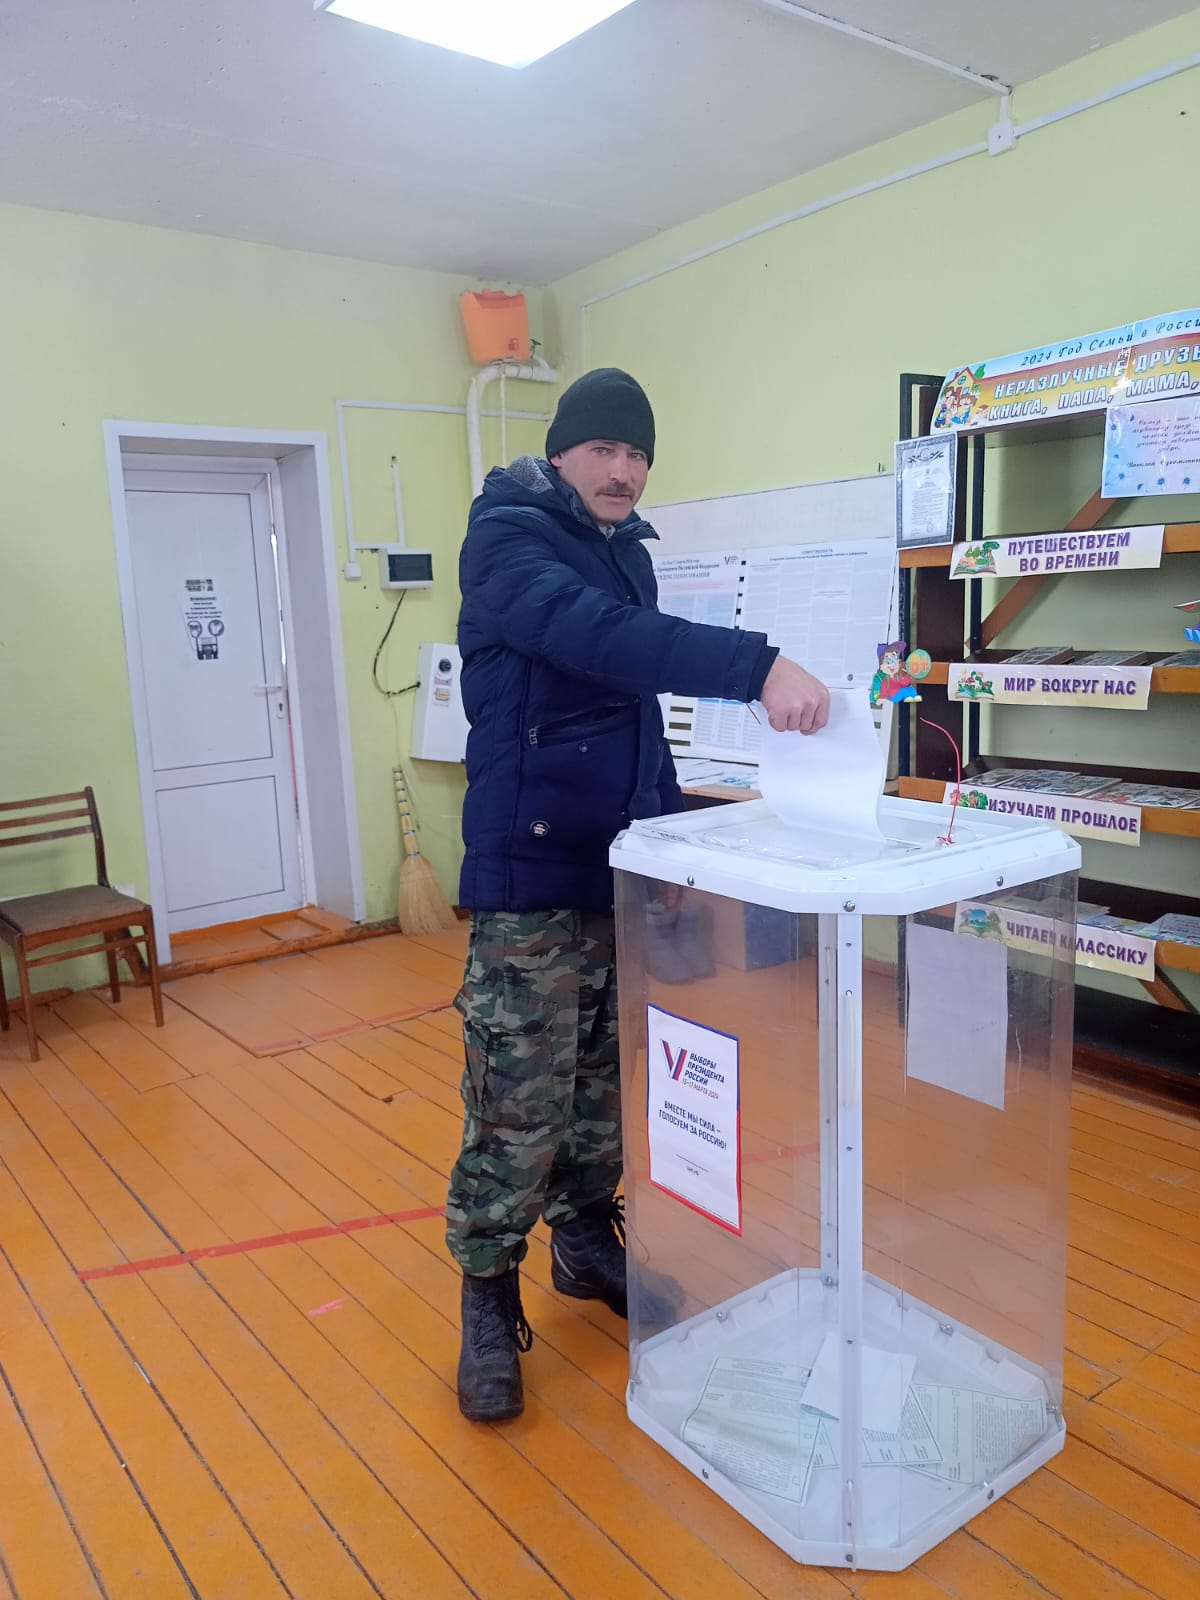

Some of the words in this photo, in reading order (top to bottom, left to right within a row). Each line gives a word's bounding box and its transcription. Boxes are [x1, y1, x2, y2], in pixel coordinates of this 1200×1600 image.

[1021, 351, 1051, 366] 2024
[1058, 342, 1083, 358] Год
[1089, 333, 1134, 351] Семьи
[1141, 329, 1148, 338] в
[993, 359, 1127, 399] НЕРАЗЛУЧНЫЕ
[987, 398, 1048, 421] КНИГА,
[1058, 385, 1113, 409] ПАПА,
[1126, 371, 1199, 398] МАМА,
[1008, 532, 1130, 556] ПУТЕШЕСТВУЕМ
[1019, 558, 1039, 572] ВО
[1045, 551, 1120, 570] ВРЕМЕНИ
[1003, 677, 1036, 692] МИР
[1041, 678, 1100, 694] ВОКРУГ
[1104, 680, 1137, 695] НАС
[988, 798, 1056, 821] ИЗУЧАЕМ
[1061, 808, 1138, 833] ПРОШЛОЕ
[687, 1061, 725, 1083] ПРЕЗИДЕНТА
[690, 1053, 717, 1069] ВЫБОРЫ
[684, 1069, 708, 1085] РОССИИ
[659, 1109, 689, 1132] ГОЛОСУЕМ
[690, 1125, 698, 1136] ЗА
[698, 1129, 727, 1151] РОССИЮ!
[664, 1100, 686, 1119] ВМЕСТЕ
[687, 1111, 698, 1124] МЫ
[700, 1117, 715, 1132] СИЛА
